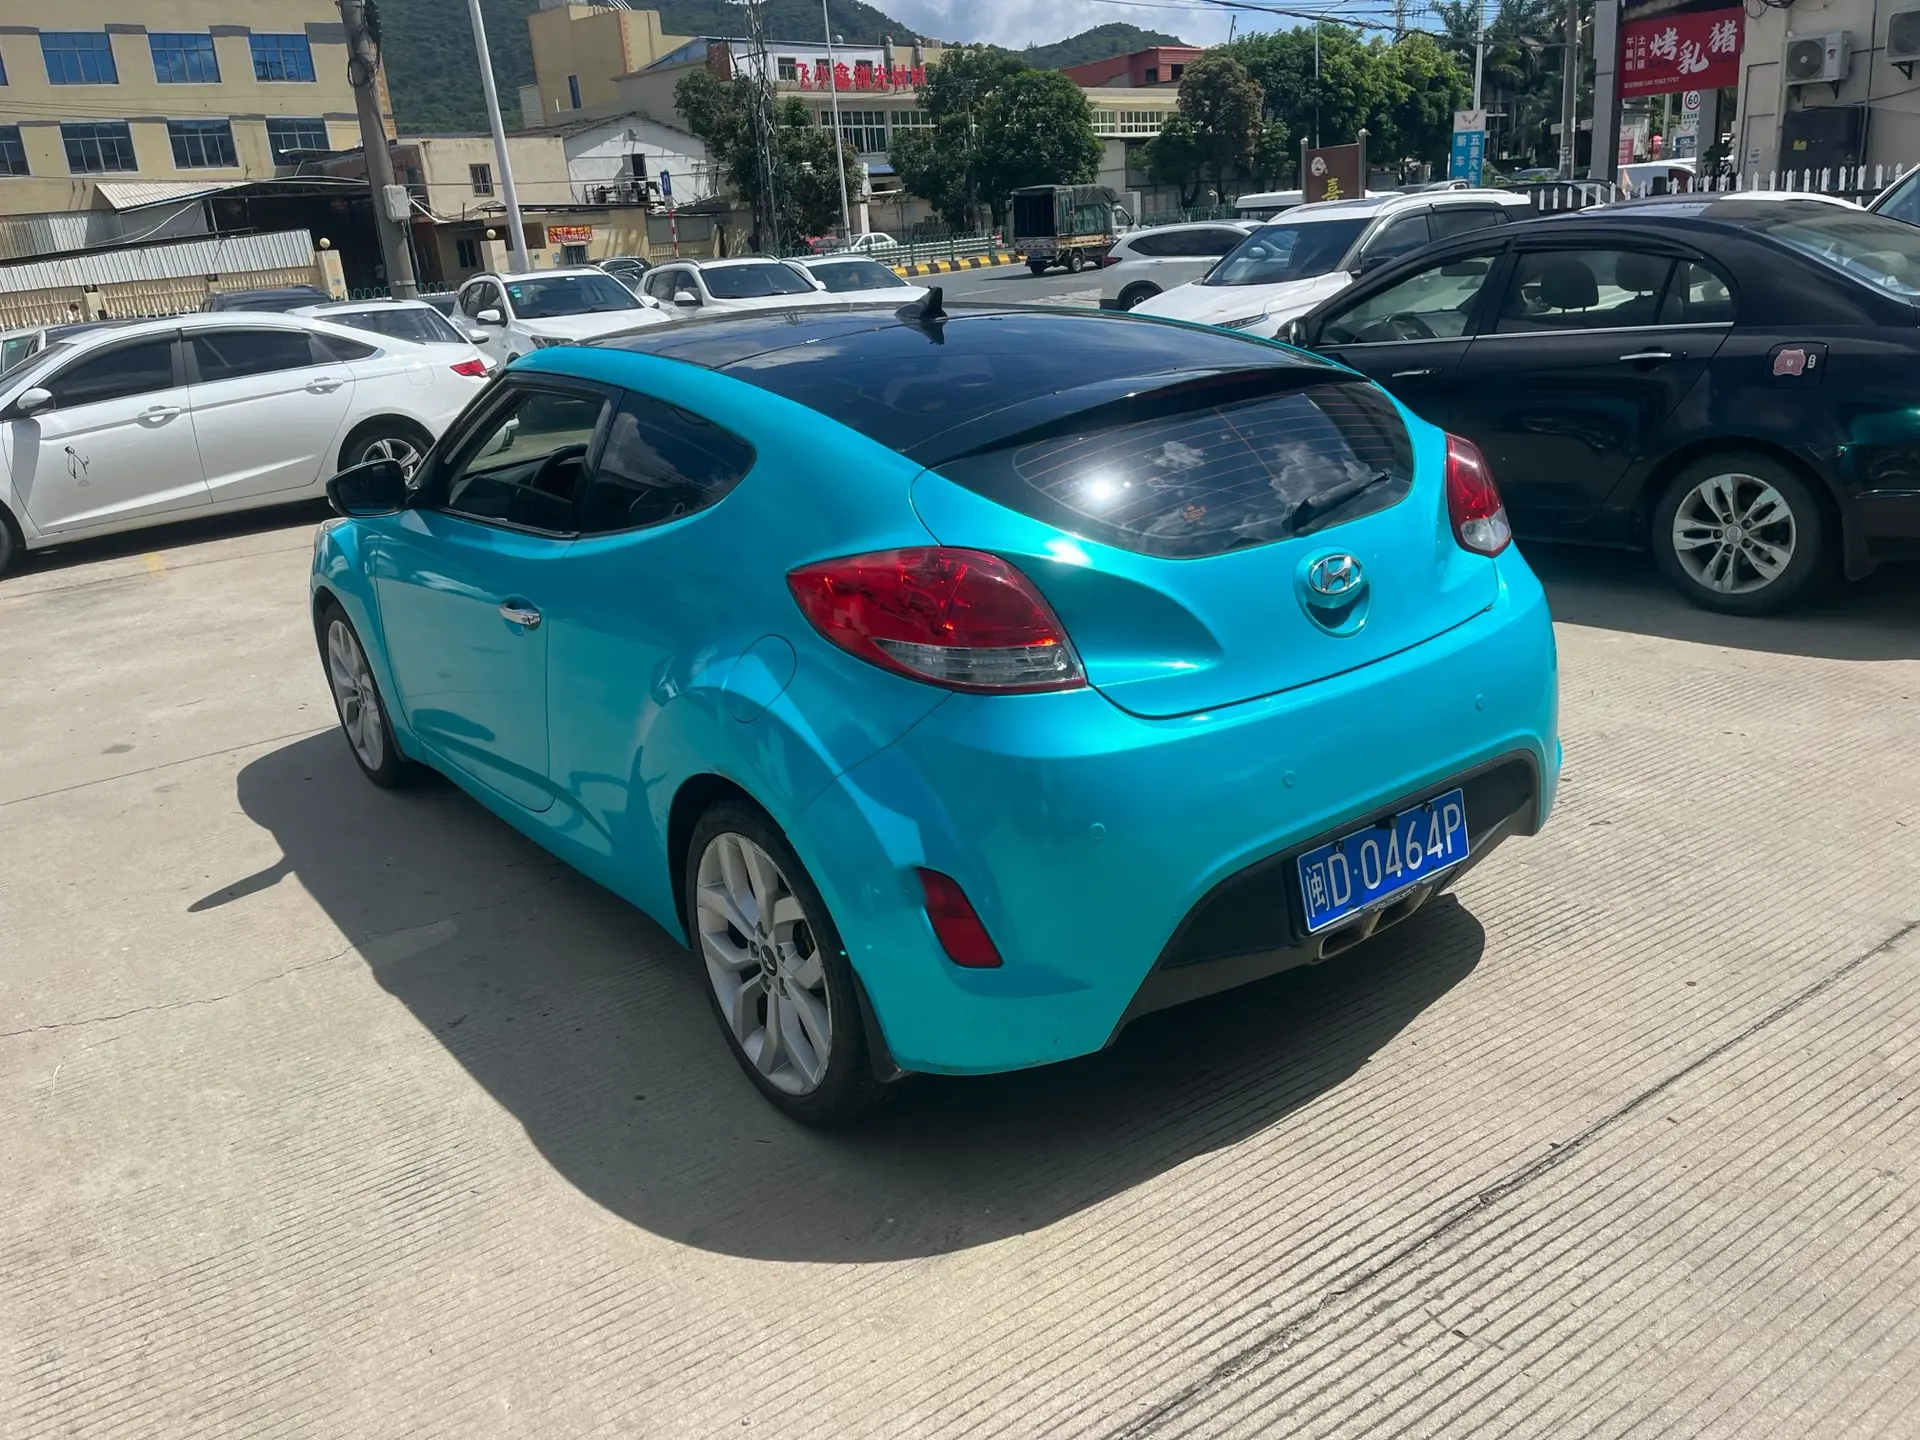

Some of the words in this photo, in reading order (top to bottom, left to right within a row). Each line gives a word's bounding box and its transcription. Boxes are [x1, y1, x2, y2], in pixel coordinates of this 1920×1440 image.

[1649, 19, 1738, 75] 烤乳猪
[1688, 94, 1699, 105] 60
[1468, 134, 1481, 188] 五菱汽车
